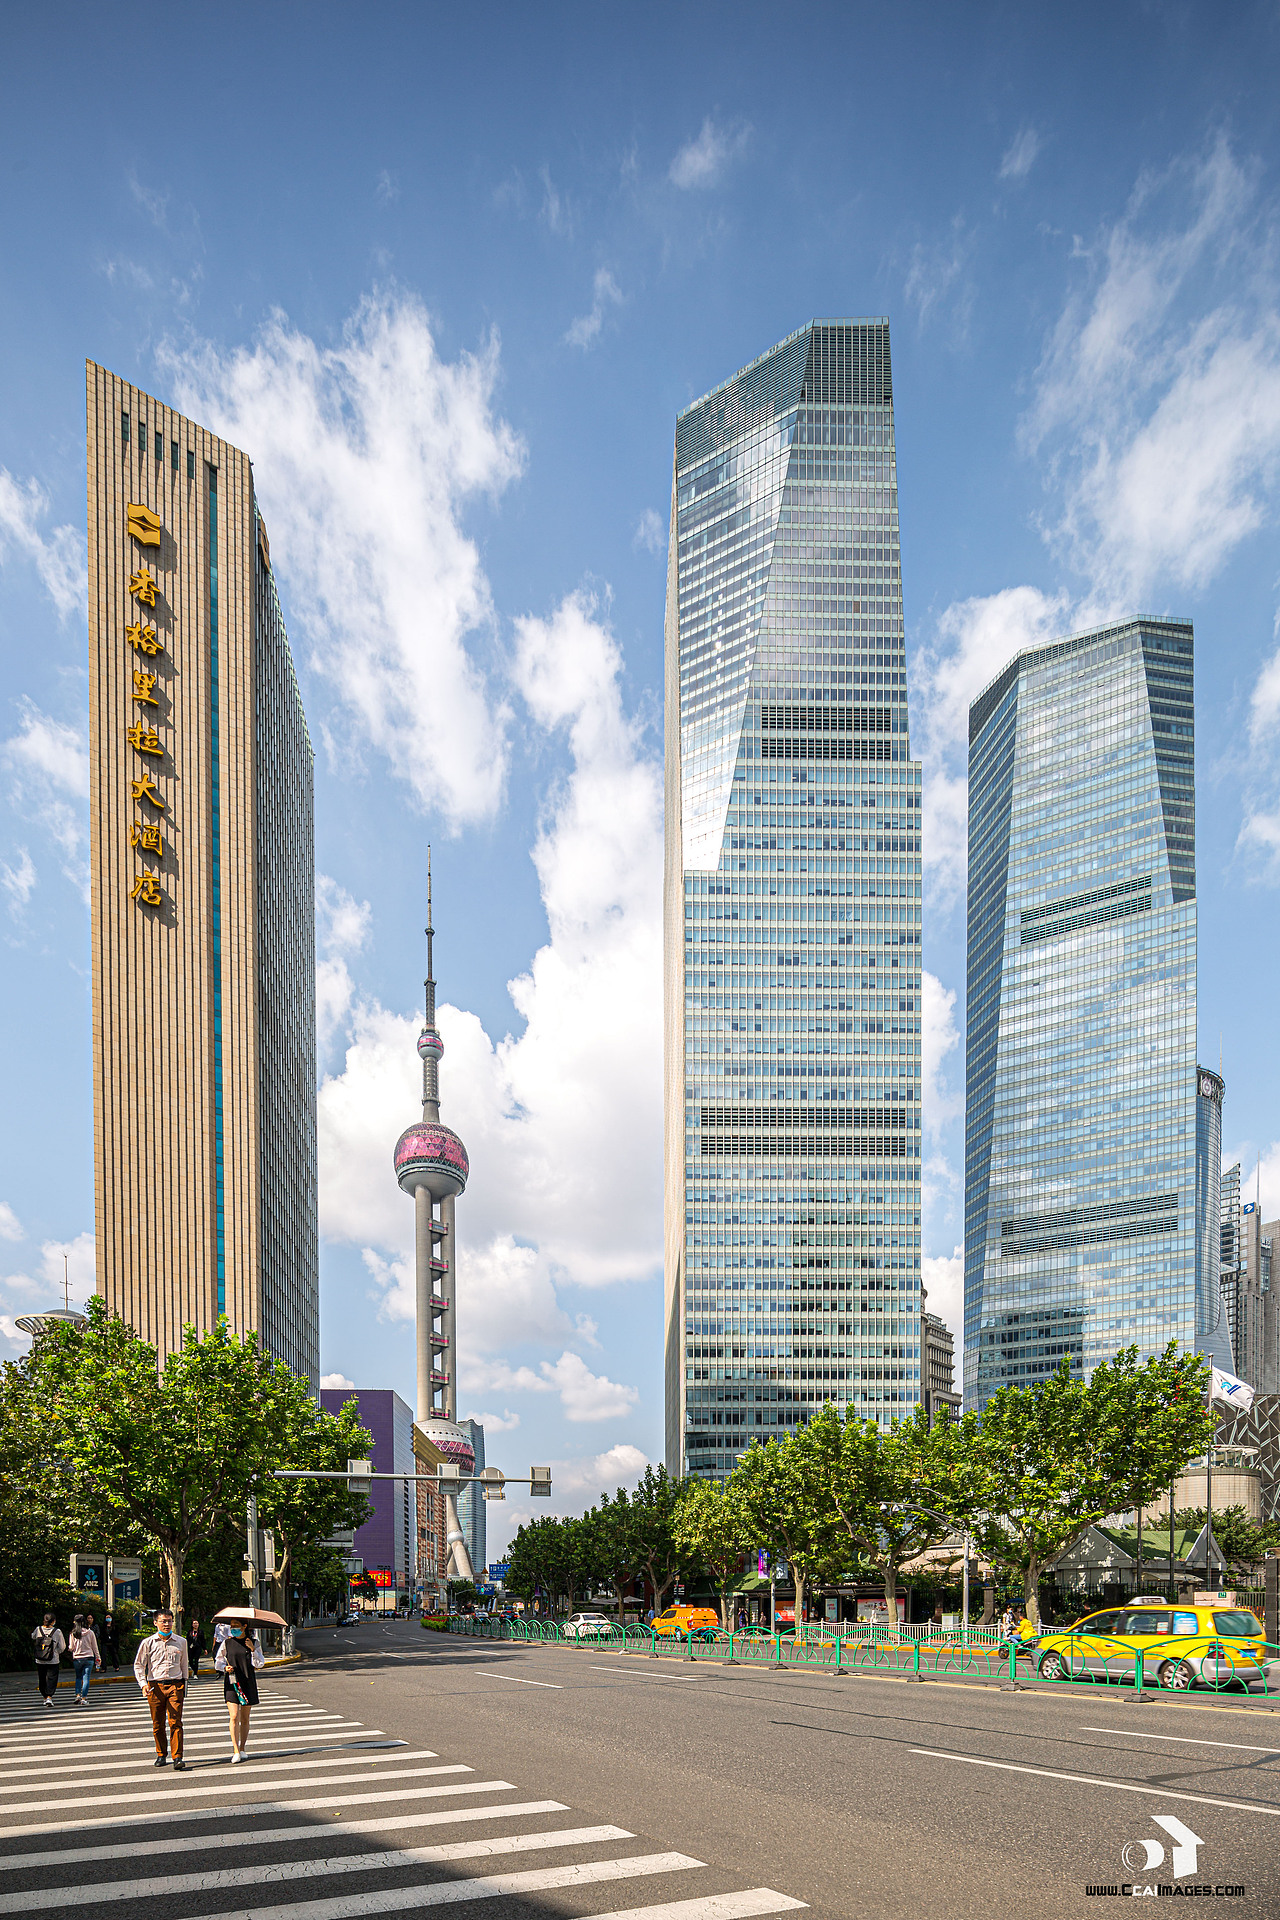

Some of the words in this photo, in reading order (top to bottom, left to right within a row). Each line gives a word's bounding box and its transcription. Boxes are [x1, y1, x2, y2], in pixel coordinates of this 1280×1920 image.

[126, 568, 164, 906] 香格里拉大酒店
